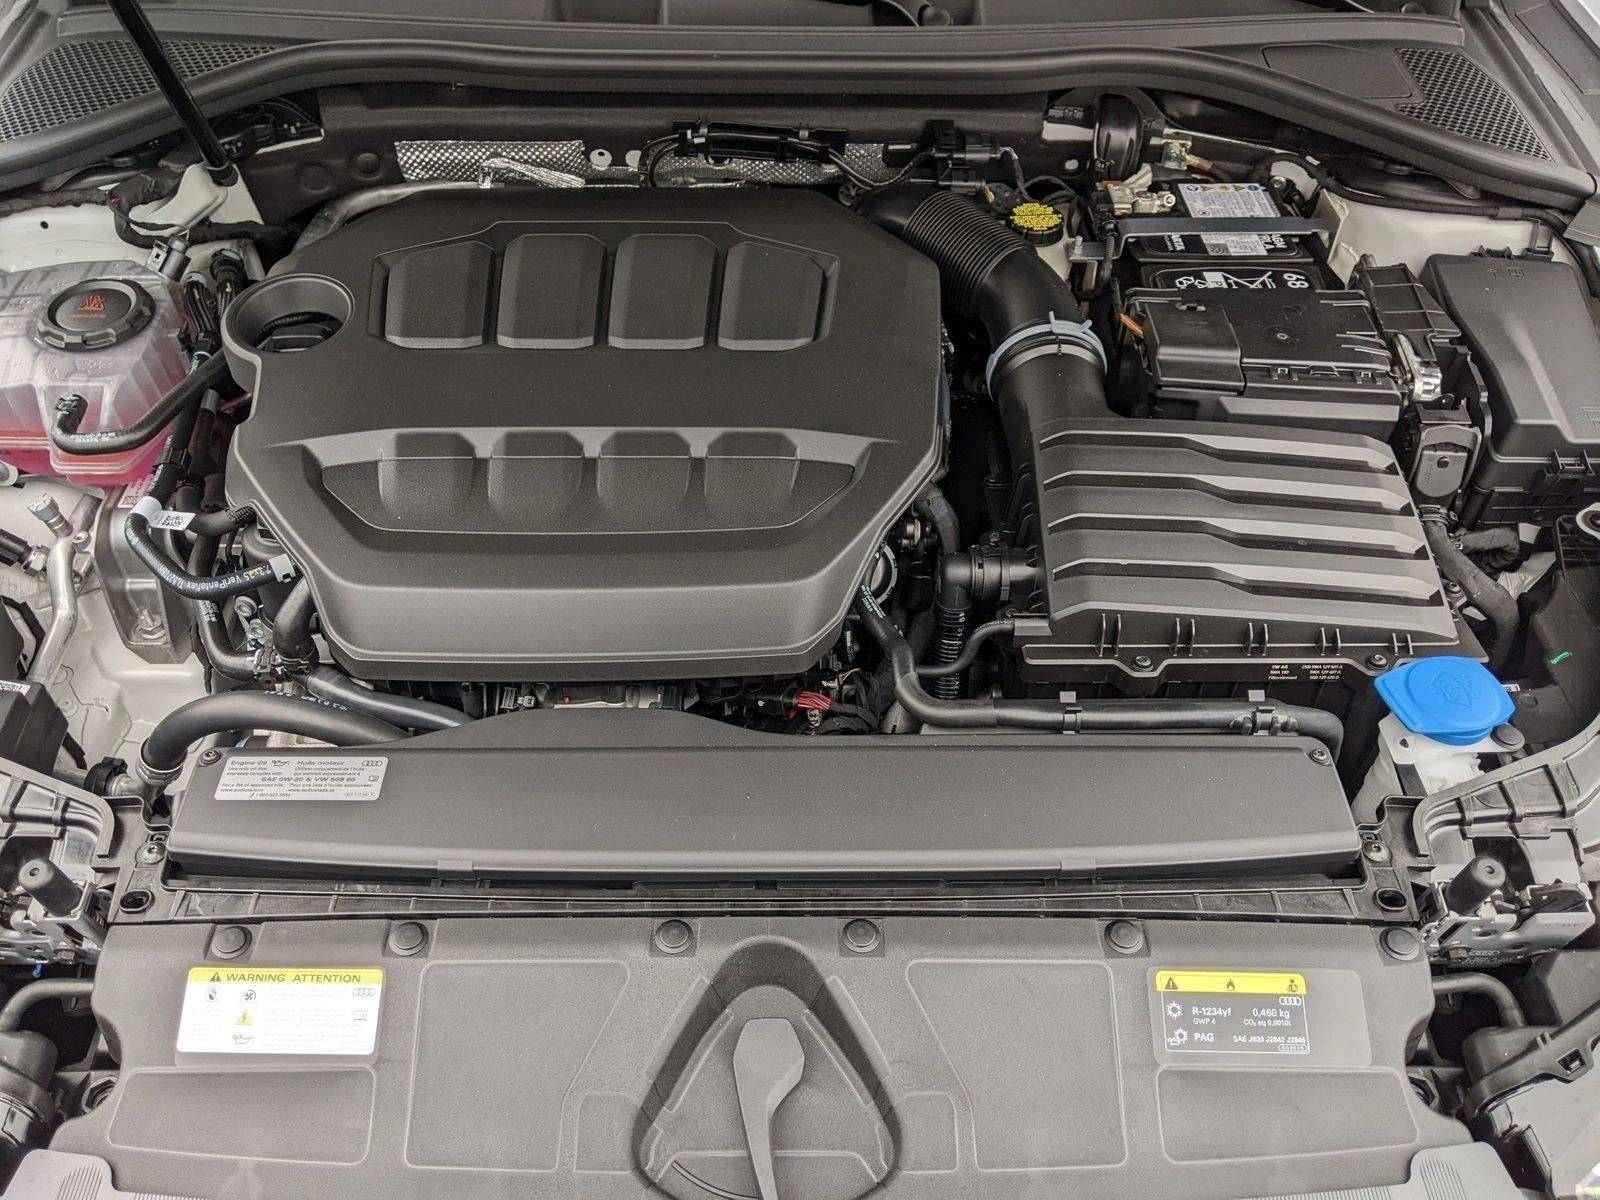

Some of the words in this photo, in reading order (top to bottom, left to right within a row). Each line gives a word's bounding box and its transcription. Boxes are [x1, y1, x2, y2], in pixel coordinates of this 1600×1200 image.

[1260, 234, 1275, 250] RLA
[1282, 273, 1309, 288] 68
[226, 974, 286, 982] WARNING
[292, 974, 361, 983] ATTENTION
[1191, 1006, 1232, 1018] R-1234yf
[1252, 1008, 1277, 1017] 0,460
[1279, 1008, 1290, 1019] kg
[1193, 1032, 1215, 1042] PAG
[1232, 1035, 1247, 1043] SAE
